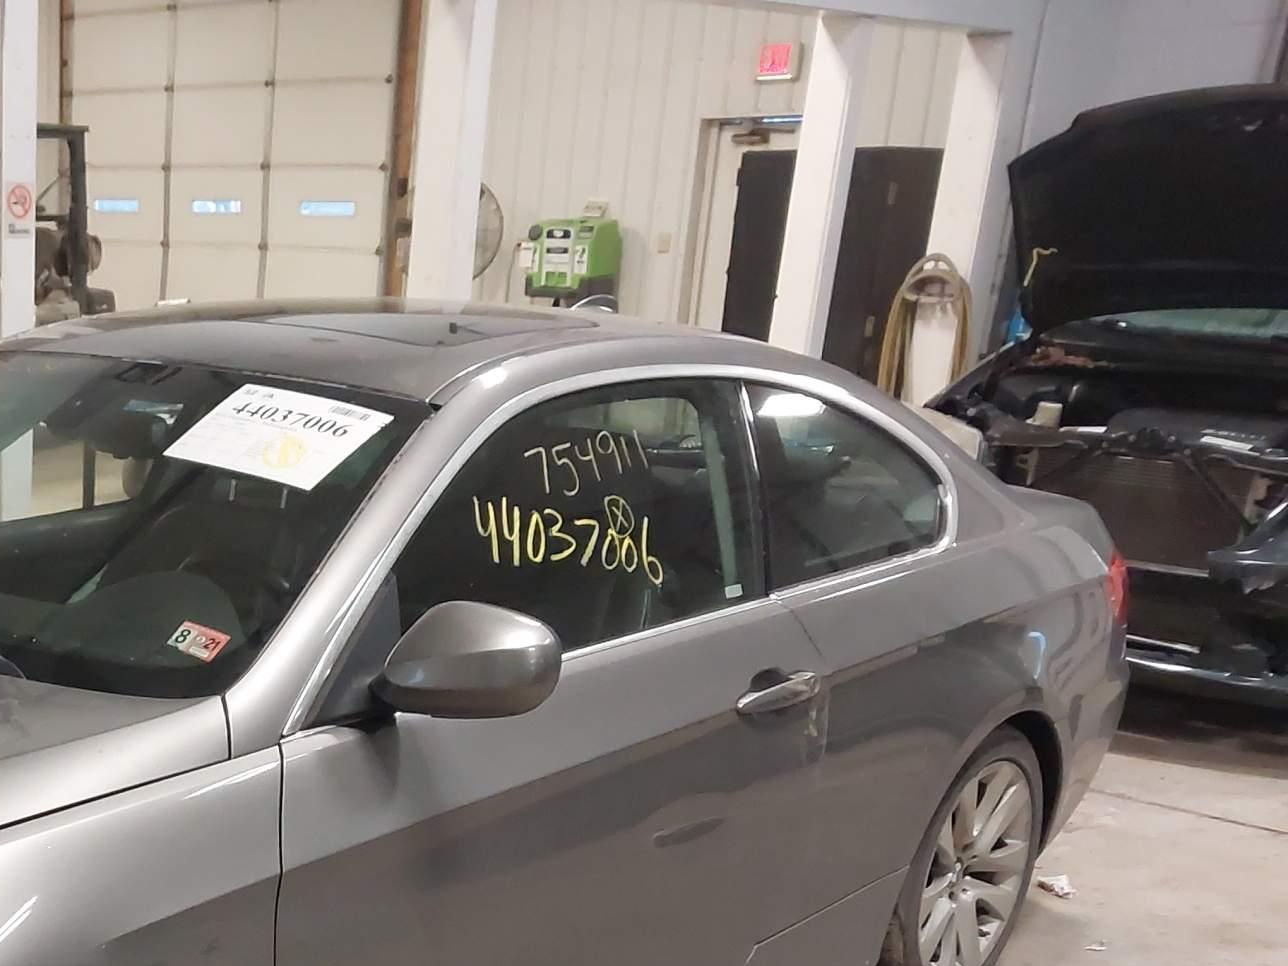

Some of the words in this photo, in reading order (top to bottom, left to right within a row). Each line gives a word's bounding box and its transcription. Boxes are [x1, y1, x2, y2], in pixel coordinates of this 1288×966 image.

[232, 402, 354, 438] 44037006
[523, 429, 649, 496] 754911
[472, 495, 664, 586] 44037006
[175, 628, 192, 644] 8
